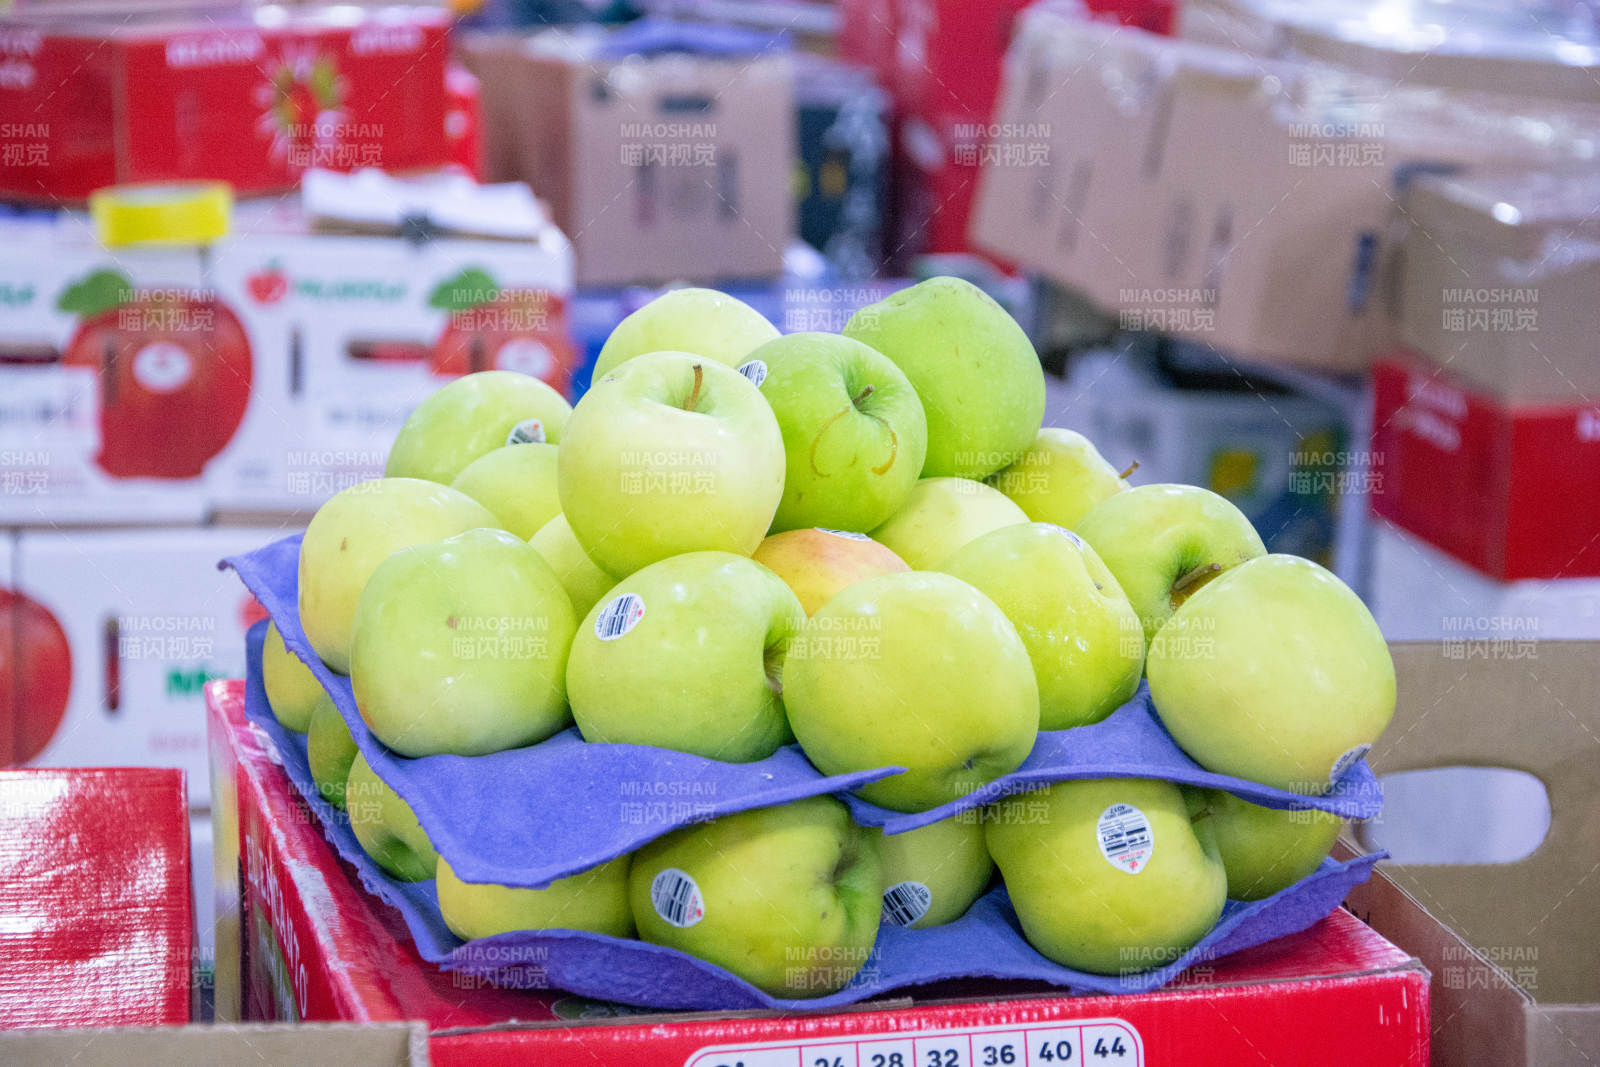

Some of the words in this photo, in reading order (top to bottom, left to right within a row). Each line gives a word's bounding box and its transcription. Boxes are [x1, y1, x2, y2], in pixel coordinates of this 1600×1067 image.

[871, 1052, 904, 1067] 28
[927, 1049, 960, 1067] 32
[983, 1045, 1016, 1066] 36
[1039, 1041, 1072, 1062] 40
[1094, 1037, 1127, 1058] 44
